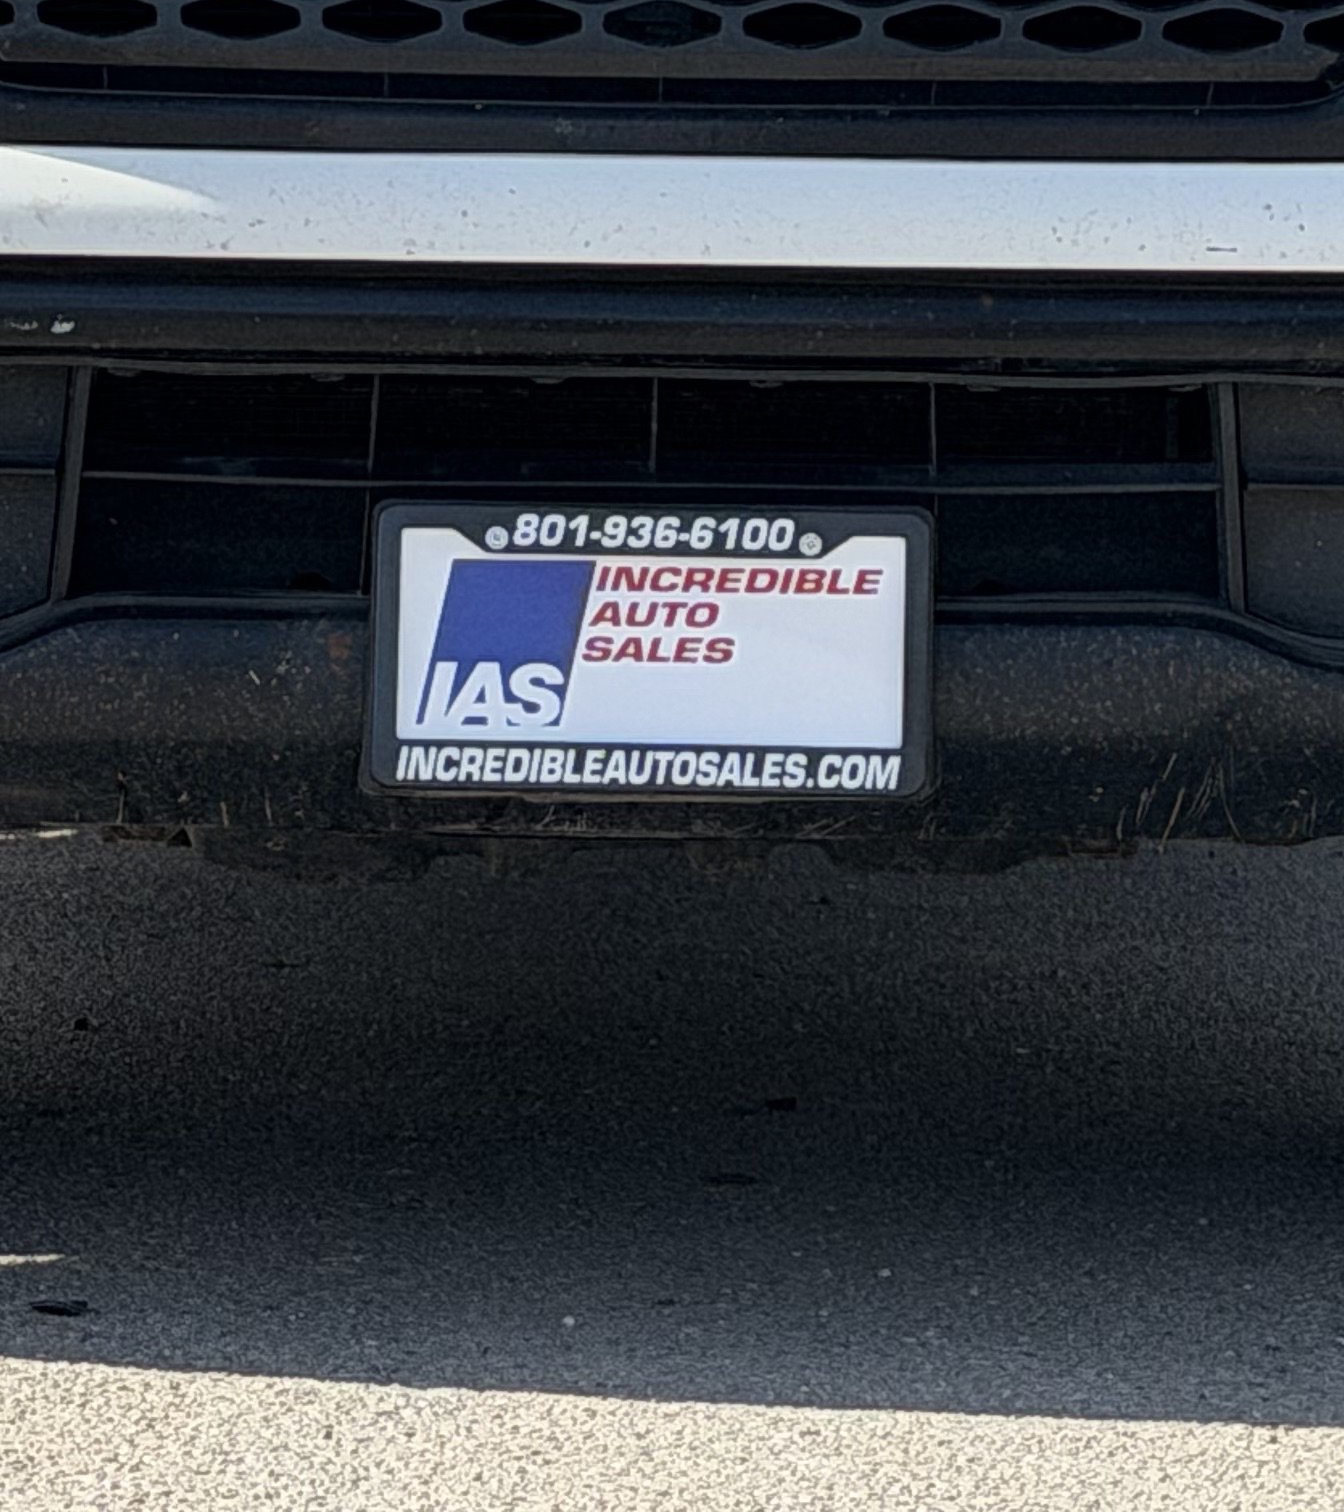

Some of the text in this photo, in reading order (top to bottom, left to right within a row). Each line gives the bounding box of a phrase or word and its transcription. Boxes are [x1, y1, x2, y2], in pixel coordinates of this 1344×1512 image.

[512, 513, 795, 552] 801-936-6100
[596, 565, 883, 595] INCREDIBLE
[588, 600, 720, 628] AUTO
[581, 636, 735, 663] SALES
[420, 660, 565, 727] IAS
[395, 745, 902, 791] INCREDIBLEAUTOSALES.COM
